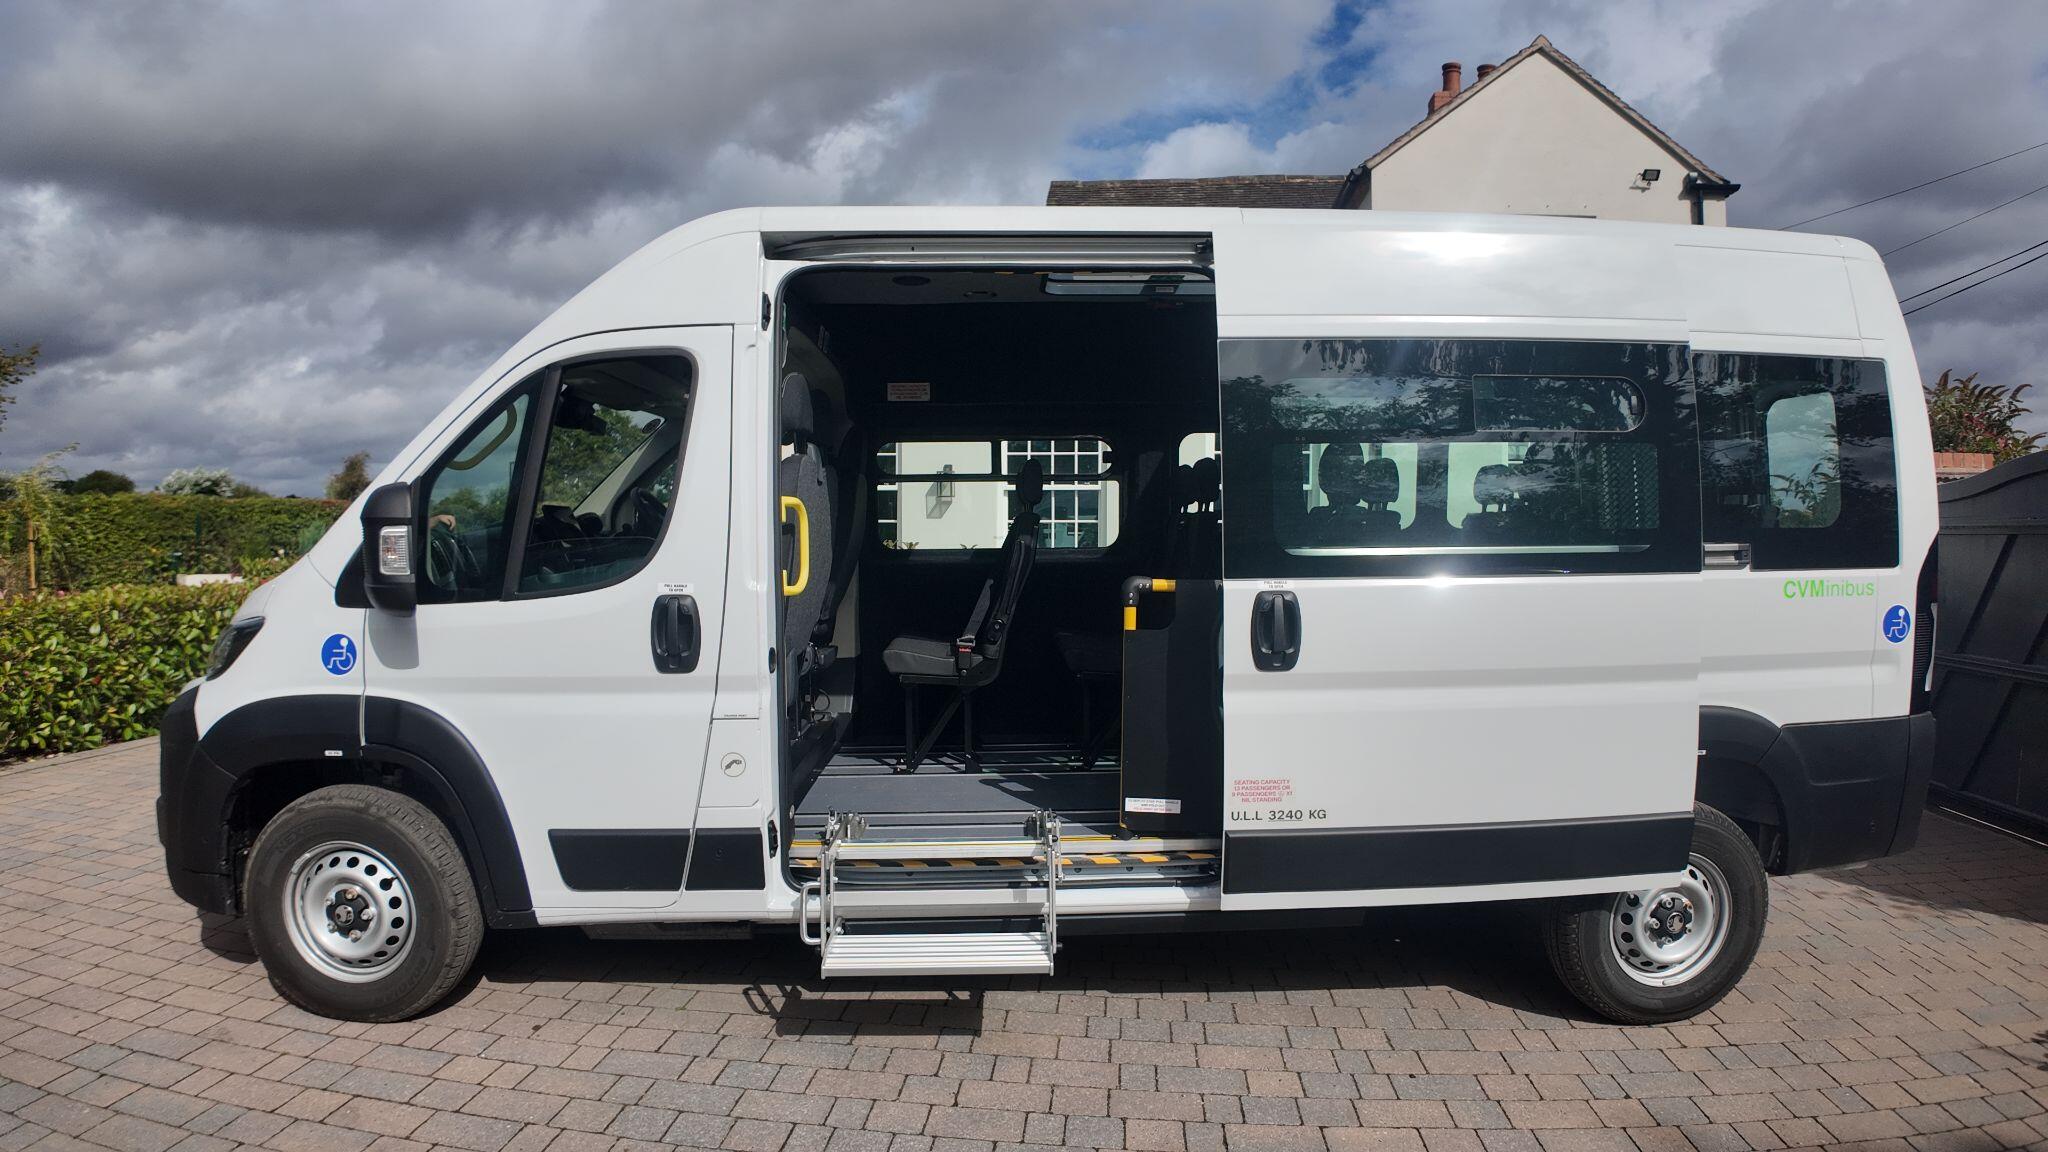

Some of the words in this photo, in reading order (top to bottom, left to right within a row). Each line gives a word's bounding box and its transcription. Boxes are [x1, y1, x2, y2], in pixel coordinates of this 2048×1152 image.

[1783, 579, 1875, 599] CVMinibus
[1268, 809, 1303, 820] 3240
[1308, 809, 1327, 820] KG
